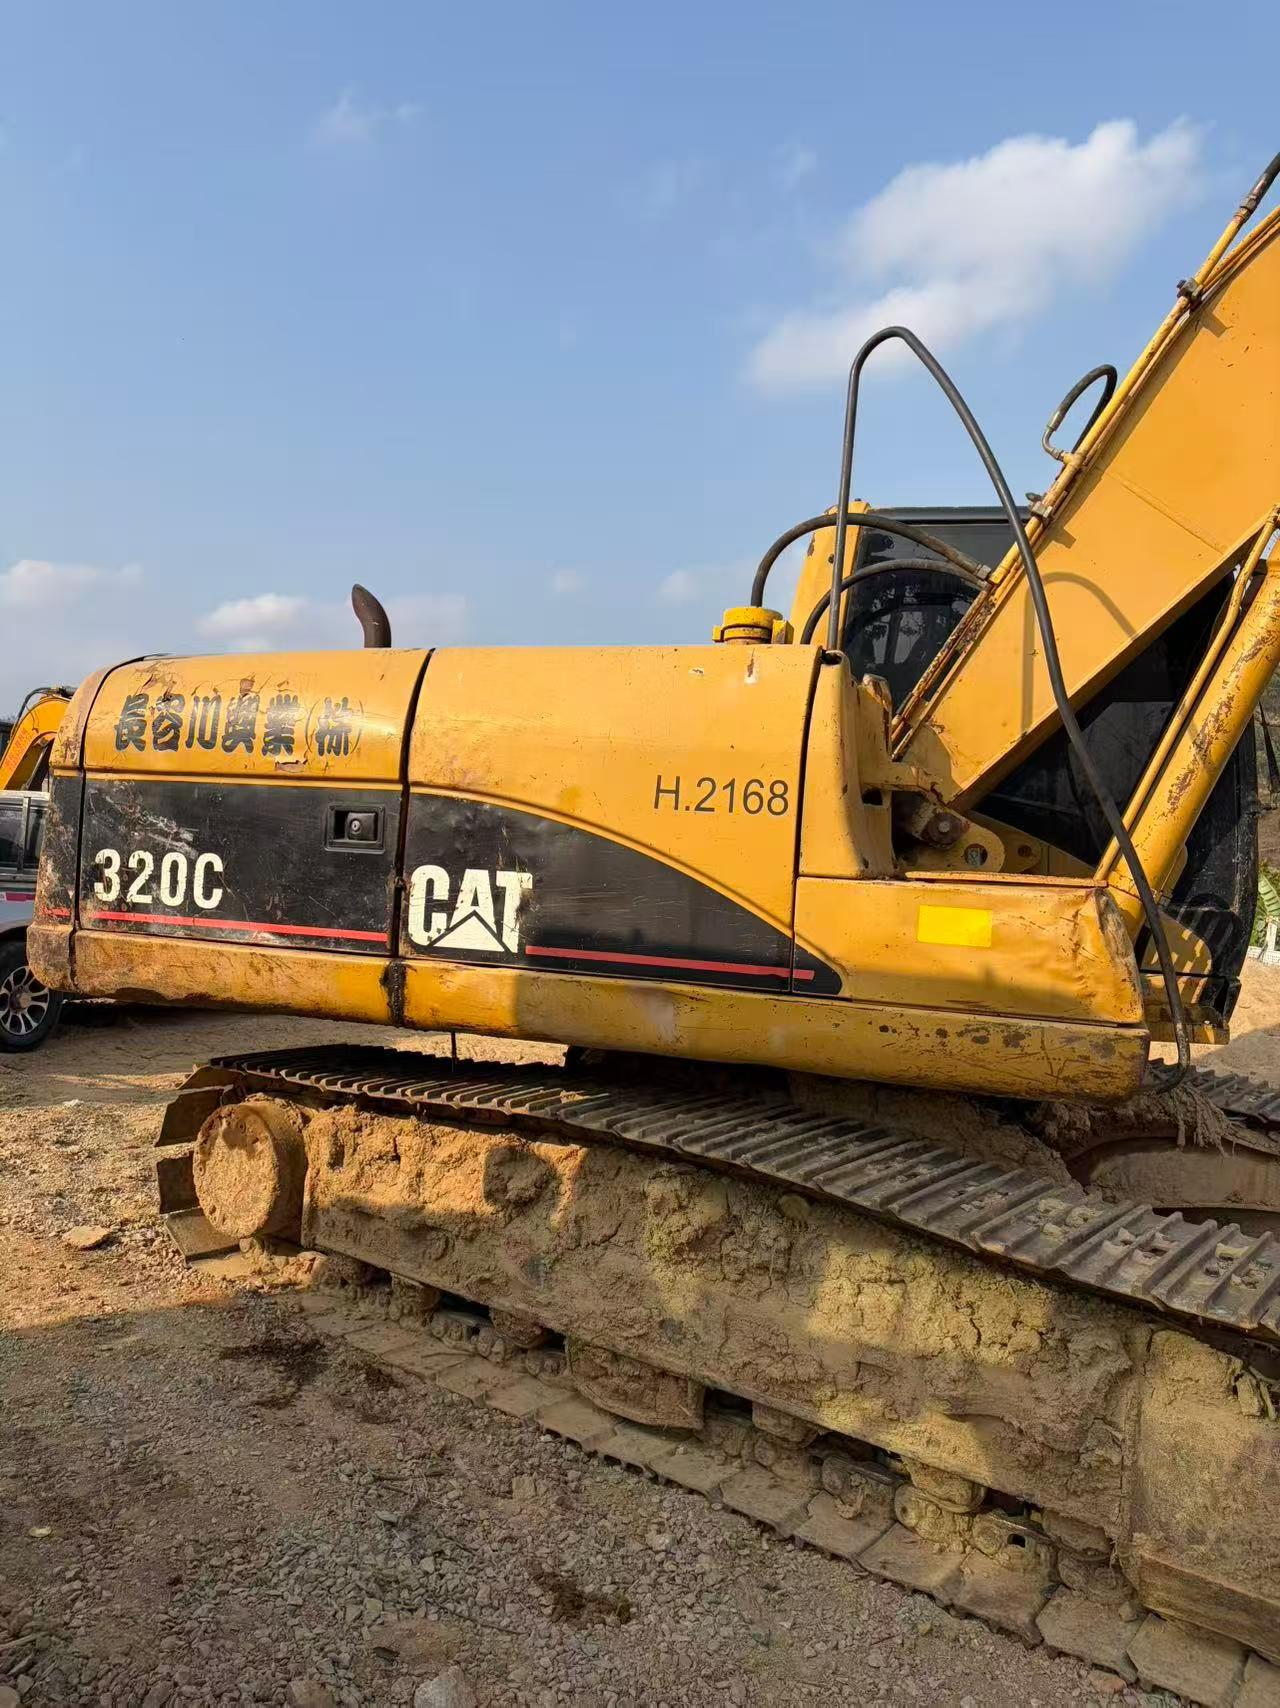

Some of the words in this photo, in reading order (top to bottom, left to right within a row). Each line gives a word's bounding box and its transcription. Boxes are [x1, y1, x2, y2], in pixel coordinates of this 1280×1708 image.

[653, 774, 789, 816] H.2168
[94, 848, 224, 909] 320C
[408, 864, 533, 953] CAT
